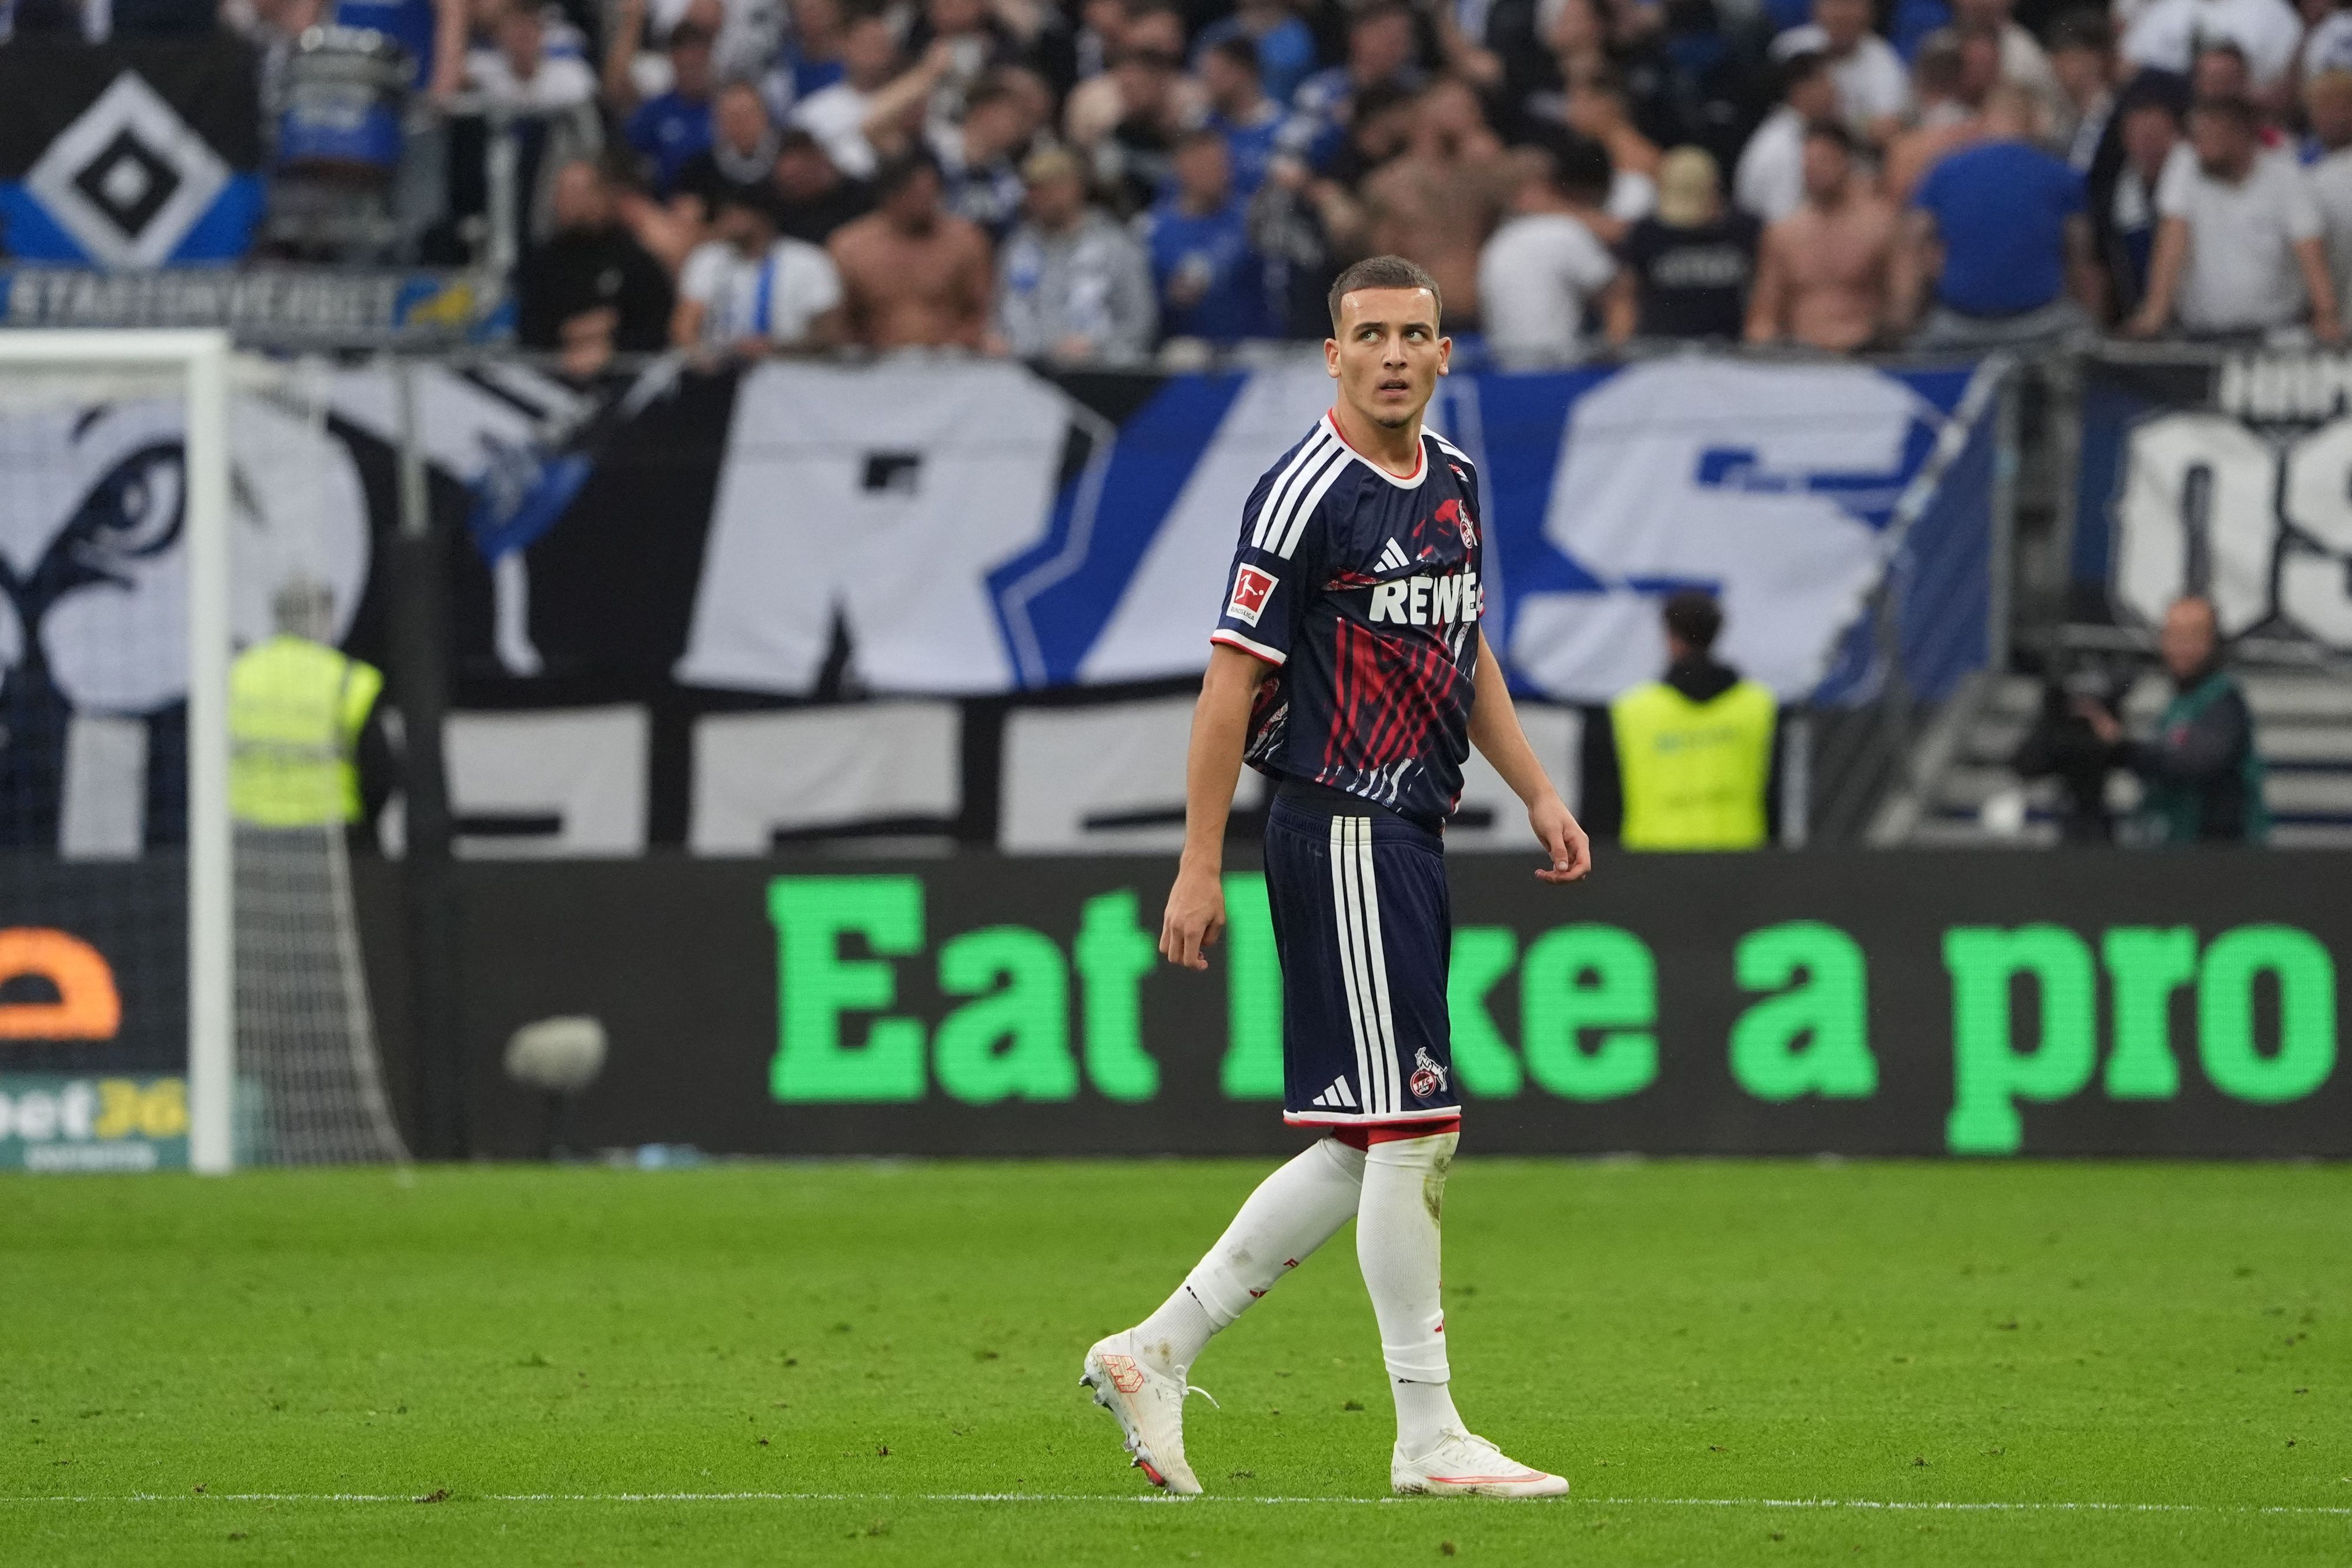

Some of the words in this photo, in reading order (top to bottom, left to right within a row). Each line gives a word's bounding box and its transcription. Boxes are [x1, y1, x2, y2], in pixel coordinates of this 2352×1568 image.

[1368, 572, 1477, 626] REWE
[767, 874, 1158, 1104] Eat
[1221, 870, 1659, 1103] lke
[1730, 920, 1877, 1102] a
[1942, 923, 2336, 1156] pro
